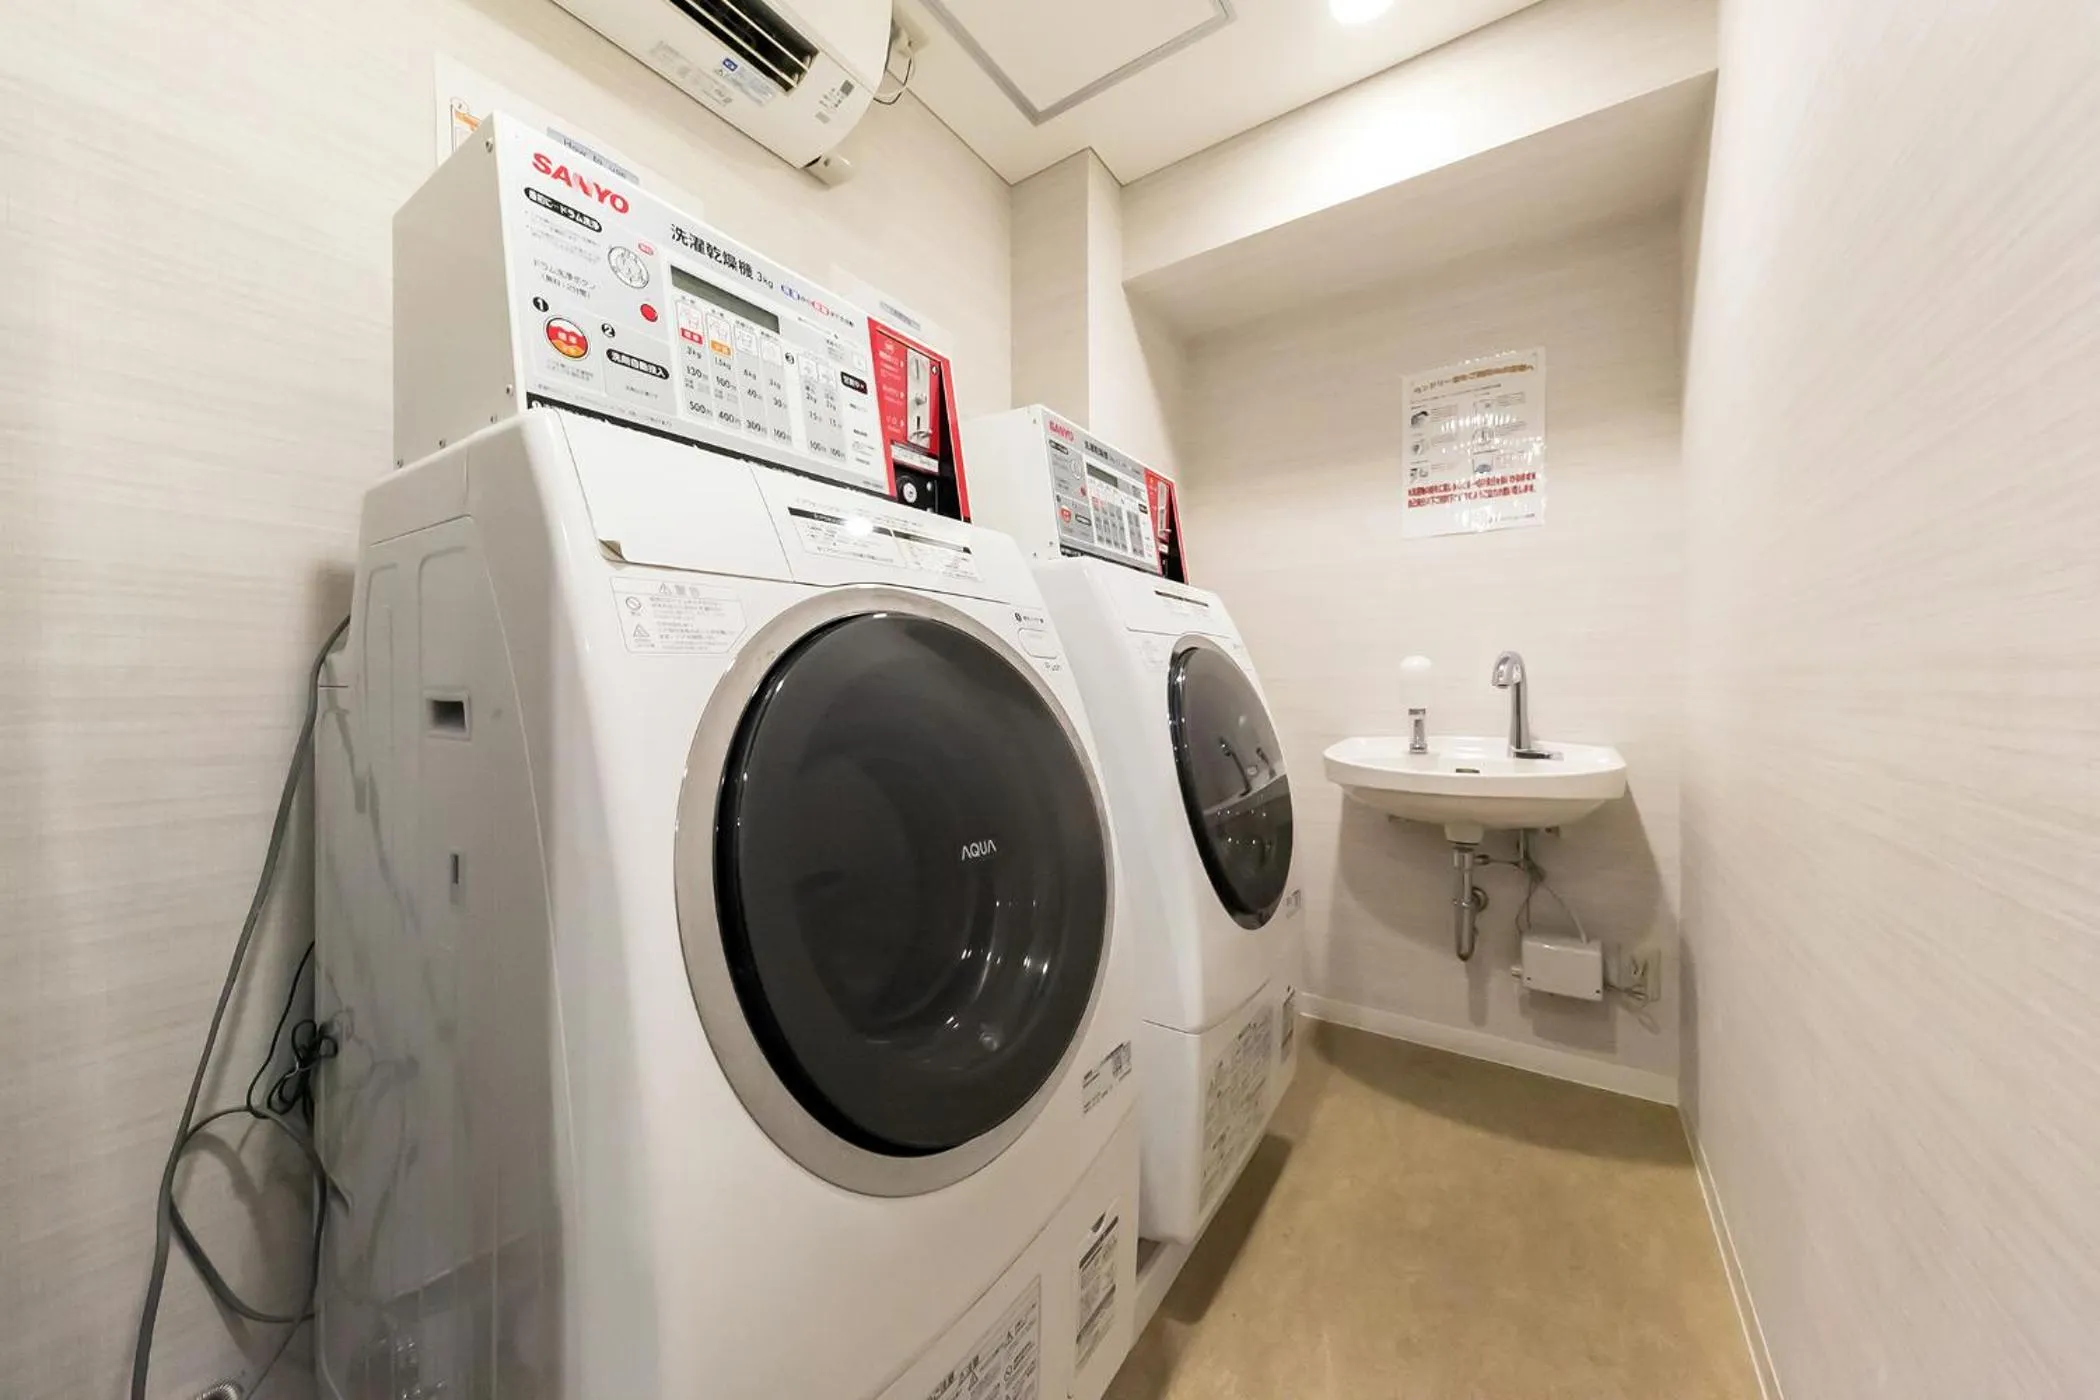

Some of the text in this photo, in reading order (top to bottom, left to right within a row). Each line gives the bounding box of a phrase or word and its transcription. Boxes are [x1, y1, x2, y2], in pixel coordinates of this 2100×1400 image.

[532, 152, 630, 214] SANYO
[671, 223, 775, 290] 洗濯乾燥機 3kg
[961, 839, 998, 861] AQUA
